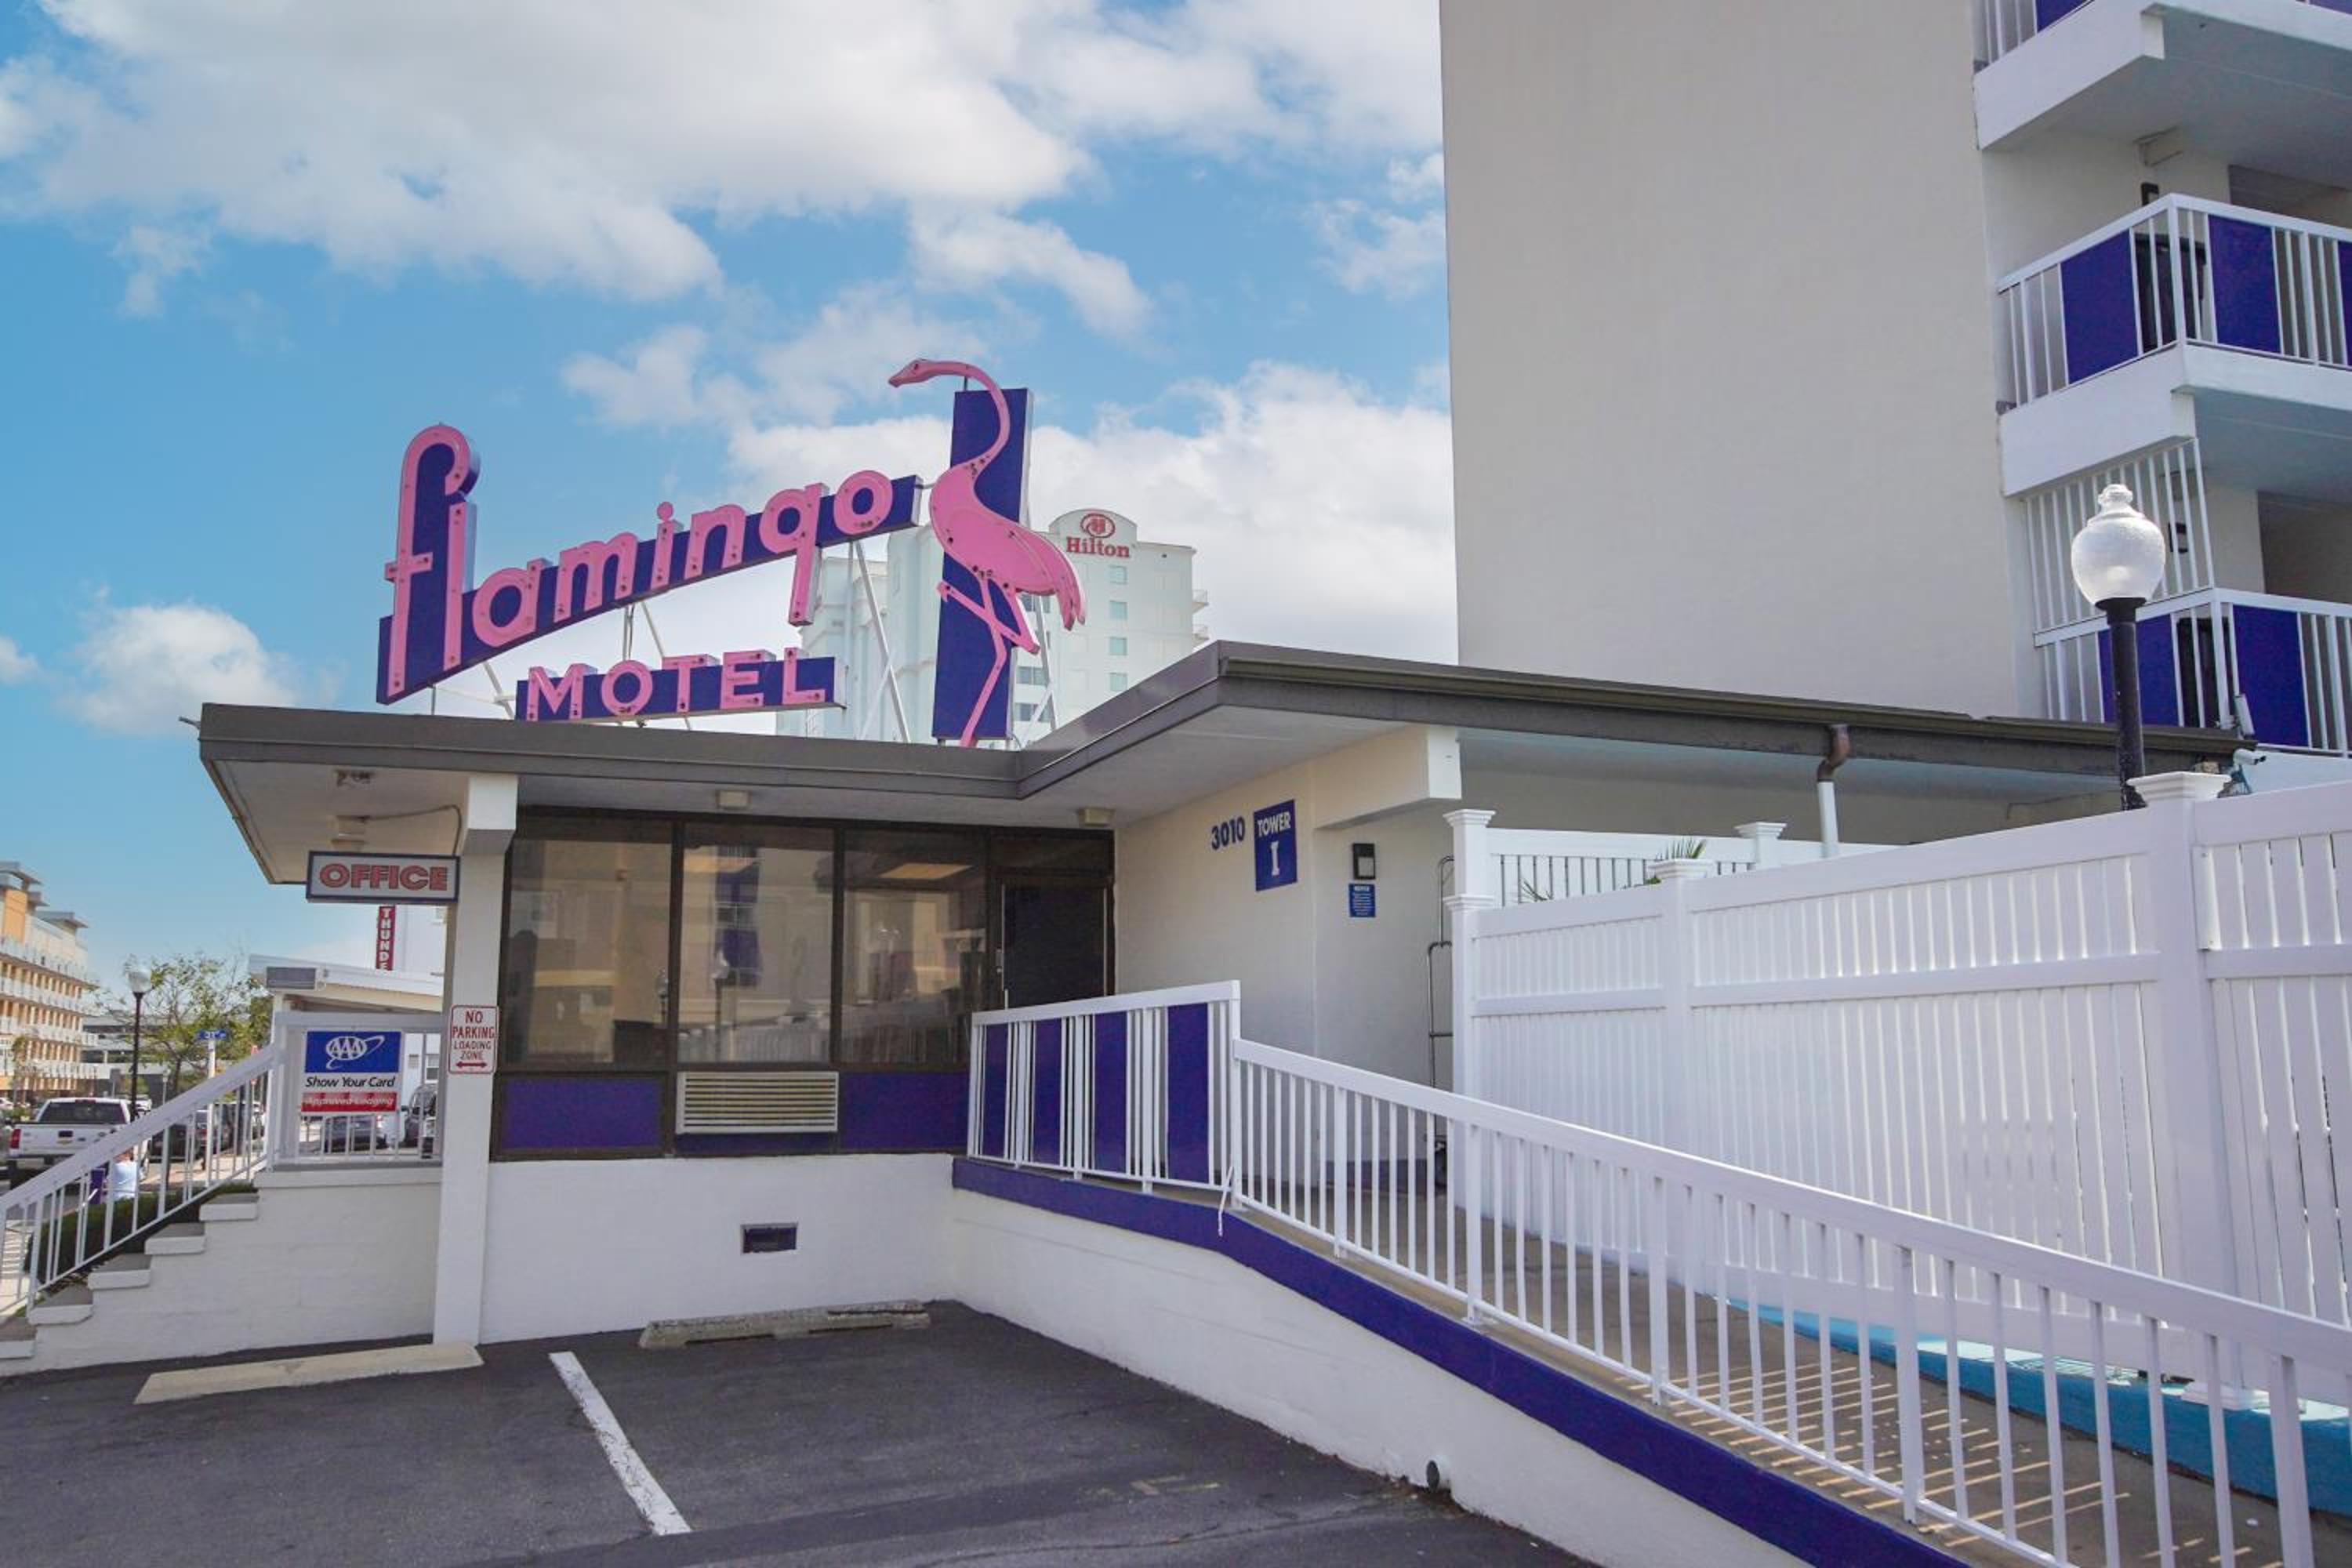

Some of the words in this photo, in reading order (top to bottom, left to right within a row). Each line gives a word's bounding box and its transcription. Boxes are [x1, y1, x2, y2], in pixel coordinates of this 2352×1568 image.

[1066, 536, 1131, 558] Hilton
[384, 424, 894, 698] flamingo
[526, 647, 826, 722] MOTEL
[1211, 816, 1246, 850] 3010
[1257, 811, 1291, 837] TOWER
[319, 863, 448, 891] OFFICE
[465, 1011, 484, 1024] NO
[452, 1026, 495, 1039] PARKING
[328, 1036, 366, 1059] AAA
[453, 1040, 492, 1050] LOADING
[459, 1051, 483, 1060] ZONE
[305, 1076, 339, 1088] Show
[342, 1076, 368, 1087] Your
[368, 1075, 396, 1087] Card
